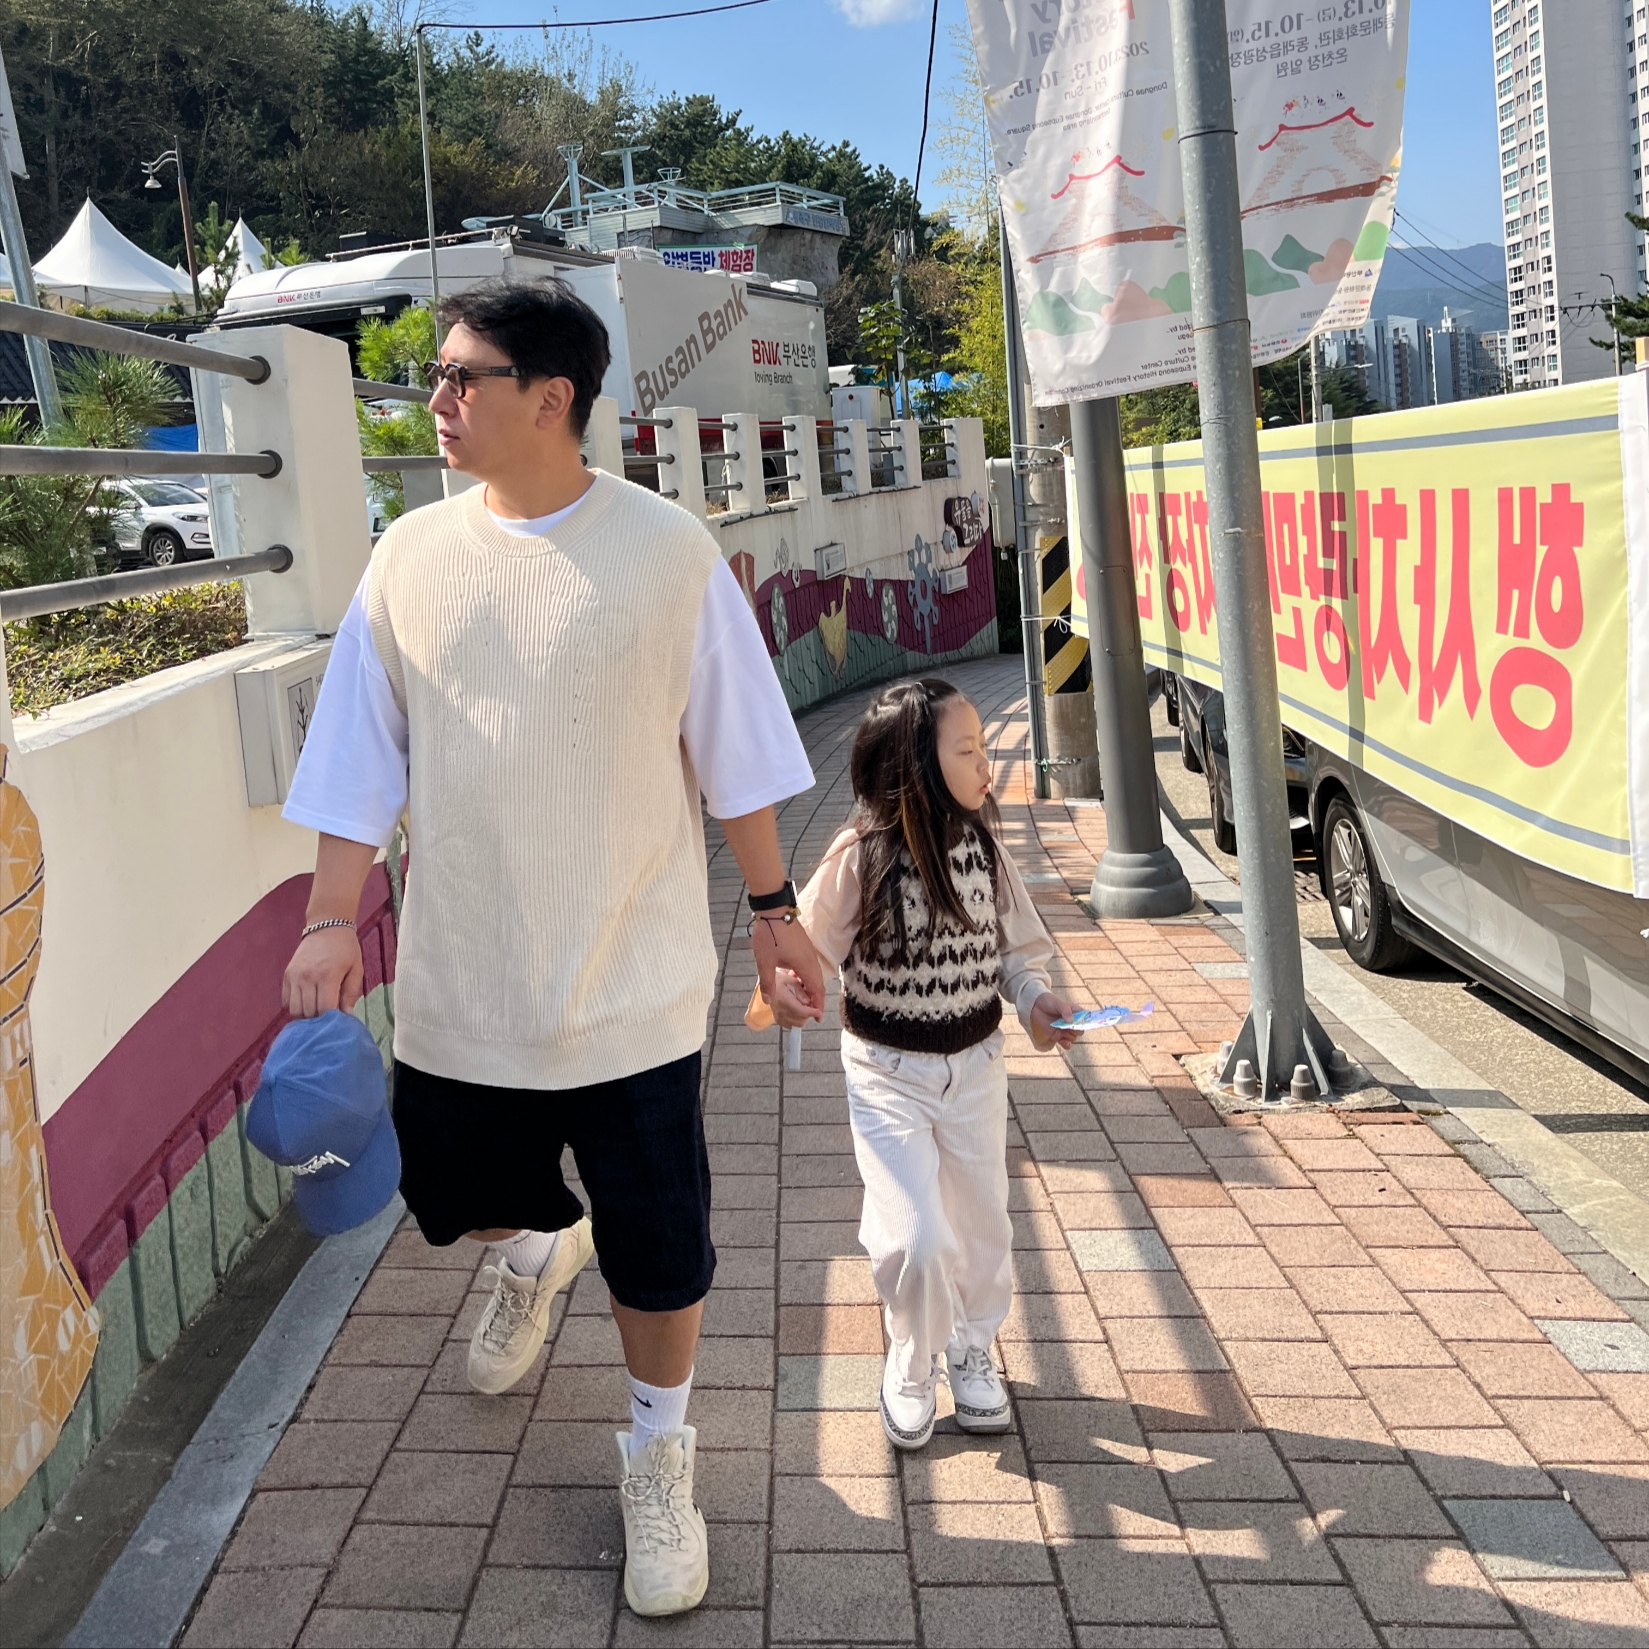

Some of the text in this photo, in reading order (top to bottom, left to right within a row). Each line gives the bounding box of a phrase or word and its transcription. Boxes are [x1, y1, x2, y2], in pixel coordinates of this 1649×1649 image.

[718, 248, 755, 273] 체험장
[277, 294, 296, 304] BNK
[633, 283, 749, 418] Busan Bank
[751, 339, 817, 369] BNK 부산은행
[773, 372, 794, 384] Branch
